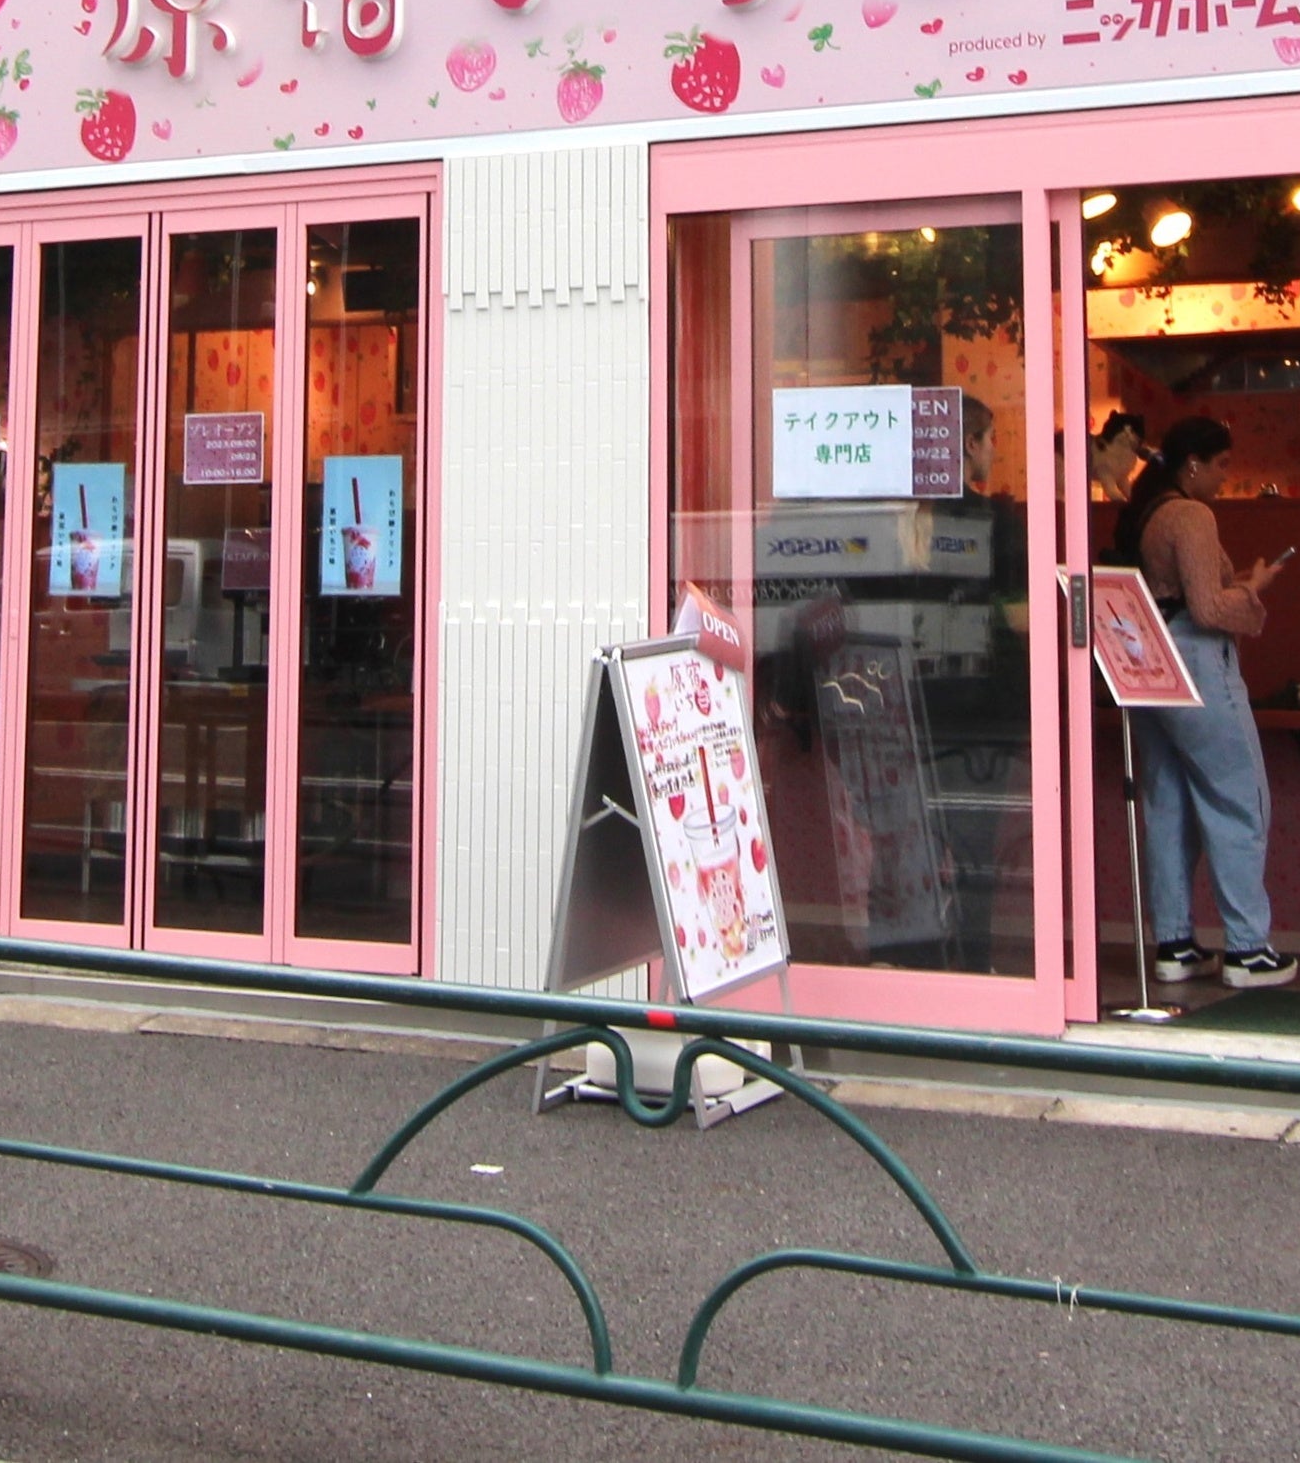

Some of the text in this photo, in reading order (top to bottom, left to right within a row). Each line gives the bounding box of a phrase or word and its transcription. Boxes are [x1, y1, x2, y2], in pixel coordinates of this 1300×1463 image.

[948, 32, 1047, 57] produced by
[783, 409, 899, 432] テイクアウト
[814, 443, 872, 464] 専門店
[702, 610, 741, 648] OPEN
